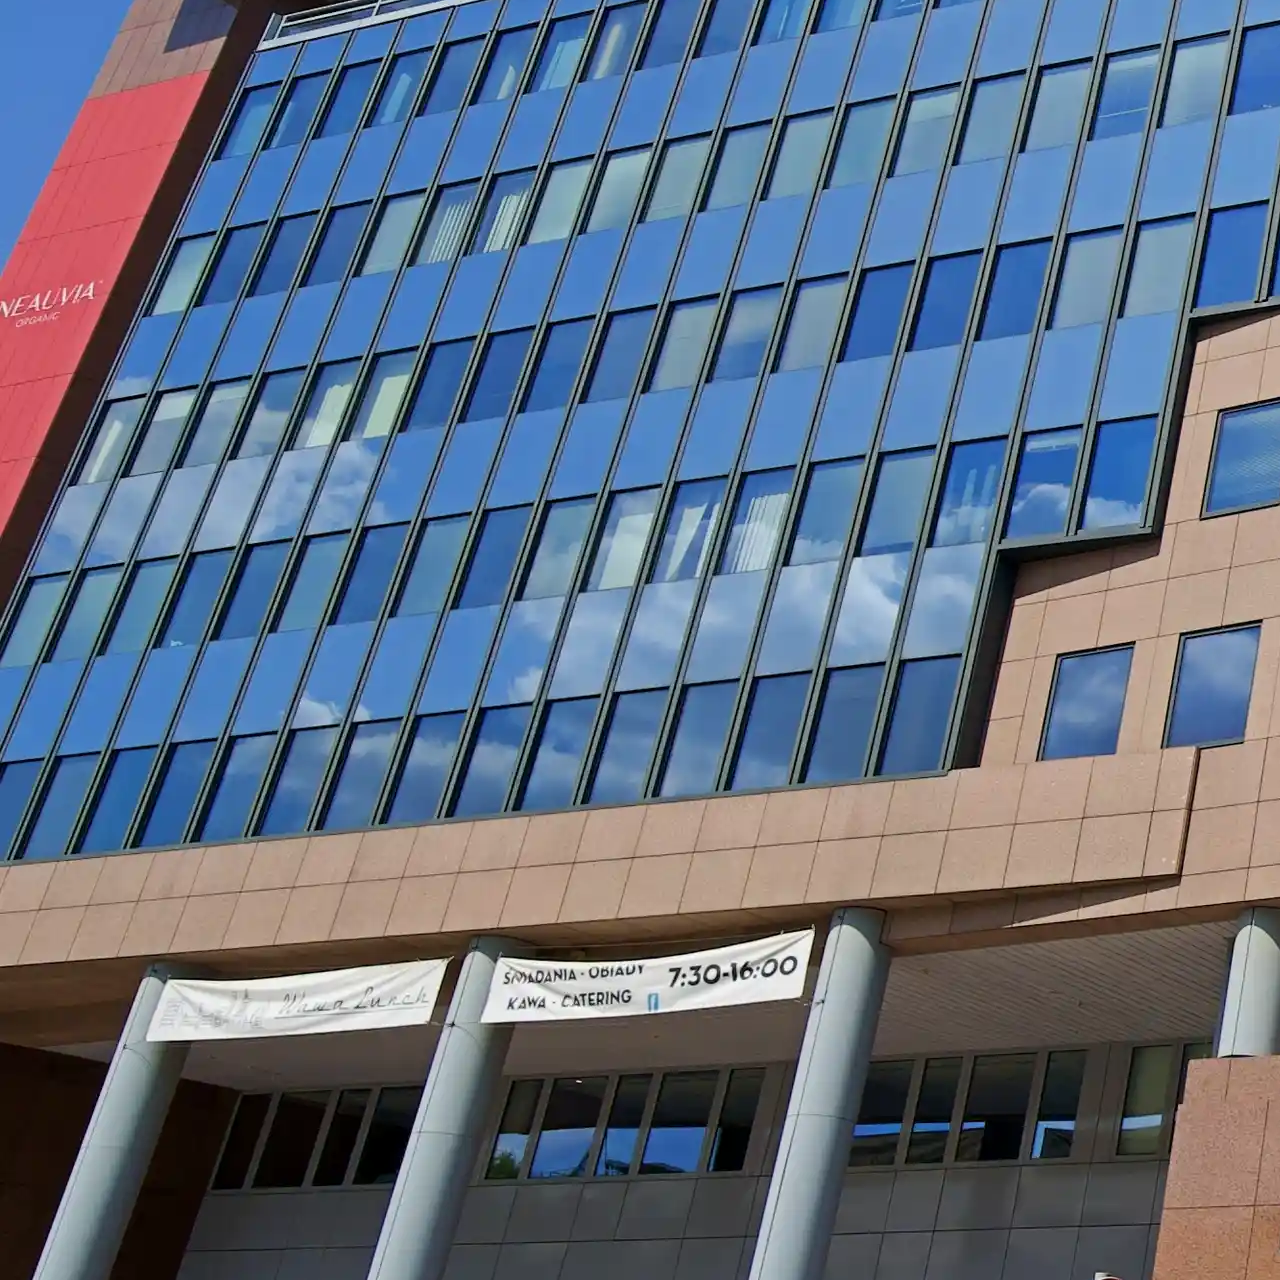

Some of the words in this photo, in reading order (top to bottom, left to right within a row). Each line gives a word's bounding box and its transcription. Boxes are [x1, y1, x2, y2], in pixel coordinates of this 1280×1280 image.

[668, 955, 799, 988] 7:30-16:00
[352, 985, 430, 1010] Lunch
[507, 995, 546, 1010] KAWA
[561, 989, 633, 1008] CATERING
